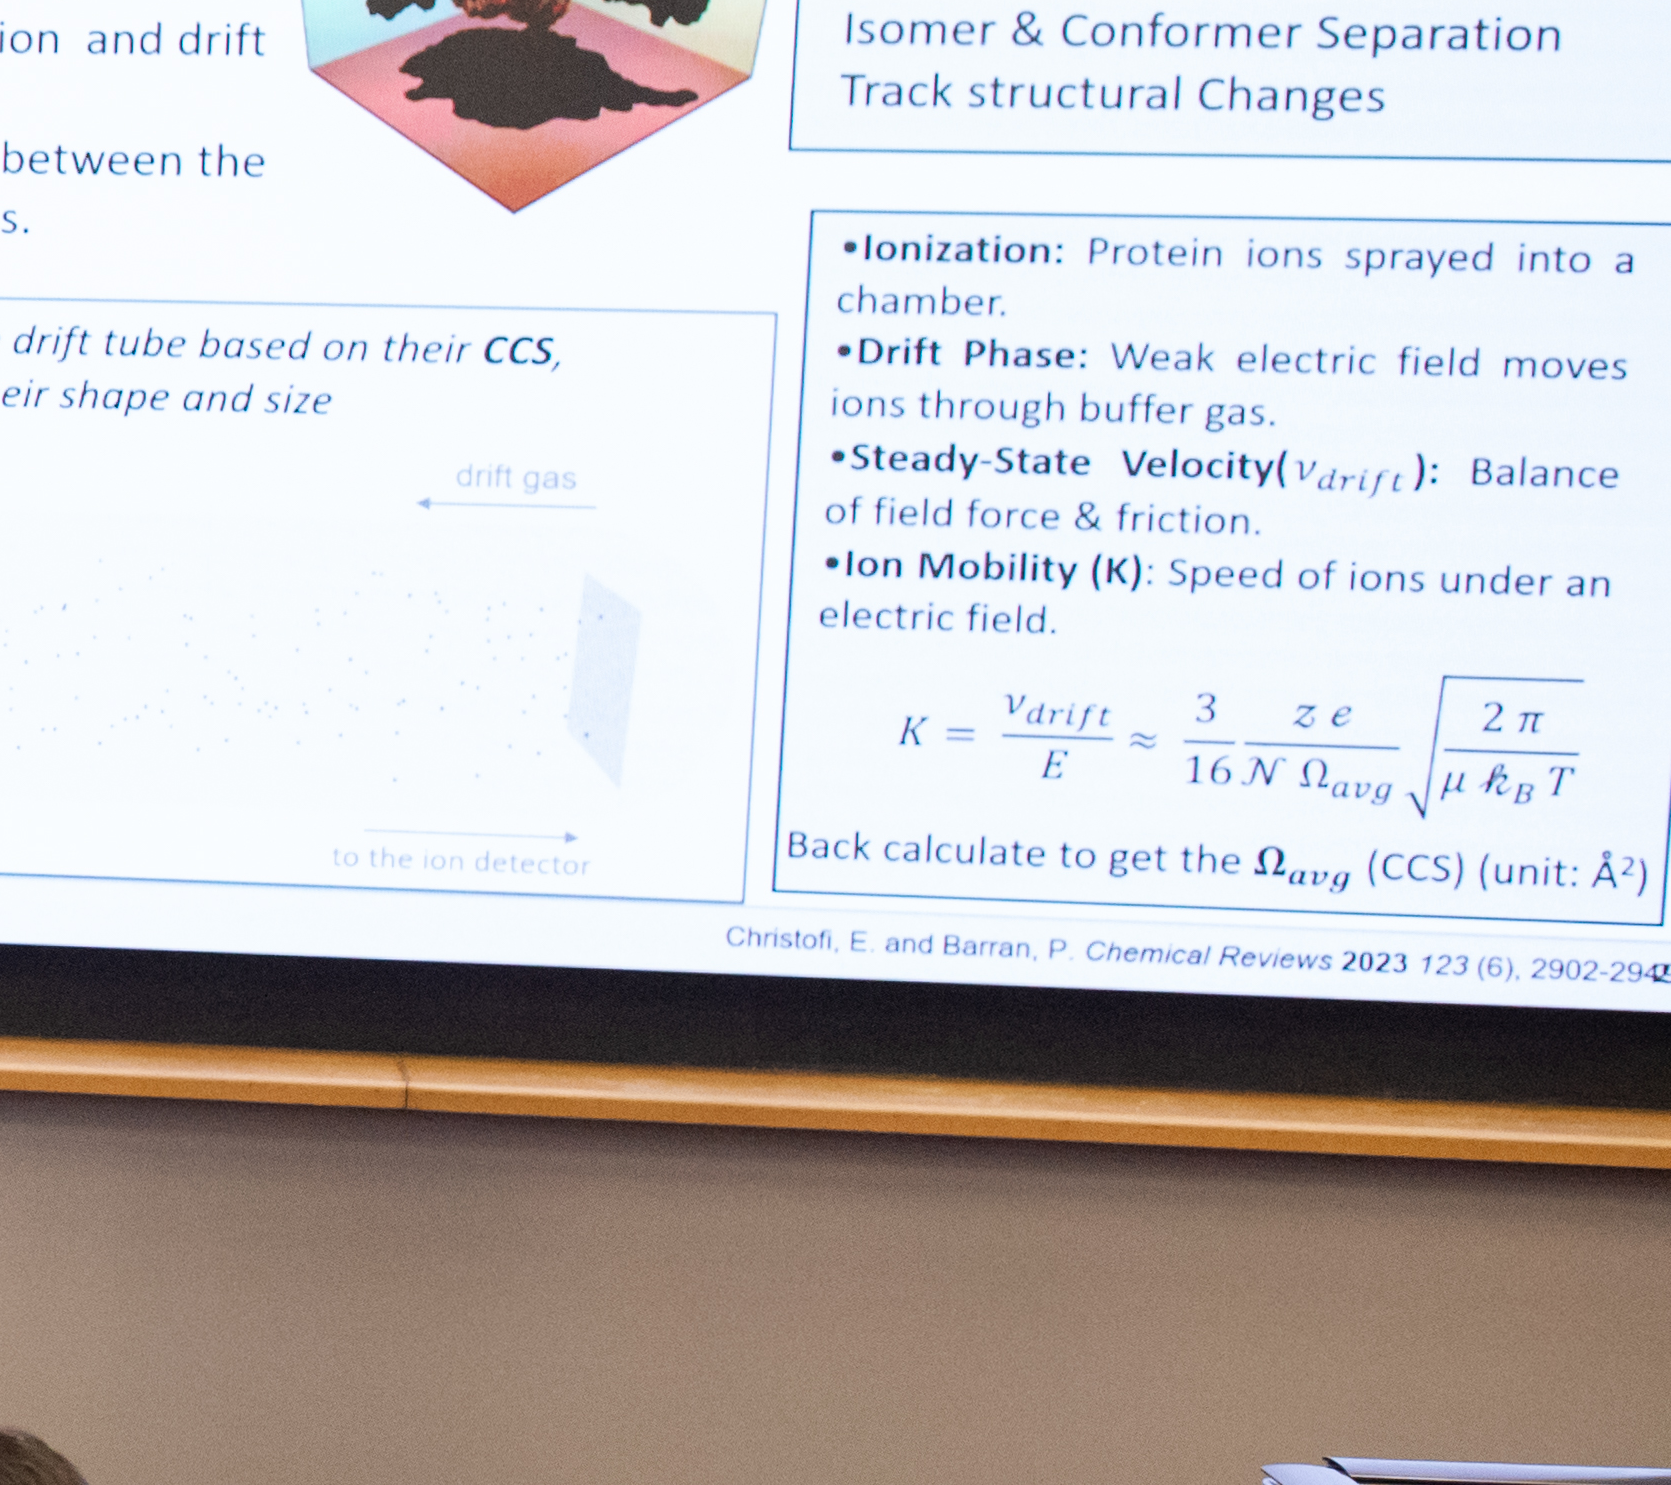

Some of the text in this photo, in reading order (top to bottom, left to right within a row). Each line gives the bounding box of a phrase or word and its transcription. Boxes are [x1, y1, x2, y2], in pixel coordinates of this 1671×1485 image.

[86, 22, 163, 56] and
[178, 22, 265, 56] drift
[845, 10, 1562, 59] Isomer & Conformer Separation
[2, 141, 182, 176] between
[198, 143, 266, 177] the
[863, 233, 1635, 279] Ionization: Protein ions sprayed into a
[12, 324, 91, 363] drift
[104, 326, 187, 358] tube
[198, 327, 313, 361] based
[322, 339, 369, 362] on
[383, 332, 472, 364] their
[482, 335, 561, 372] CCS,
[857, 336, 1628, 381] Drift Phase: Weak electric field moves
[455, 463, 578, 495] drift gas
[845, 550, 1611, 598] Ion Mobility (K): Speed of ions under an
[333, 846, 590, 876] to the ion detector
[787, 831, 1579, 891] Back calculate to get the (CCS) (unit:
[725, 925, 1521, 983] Christofi, E. and Barran, Chemical Reviews 2023 123 (6),
